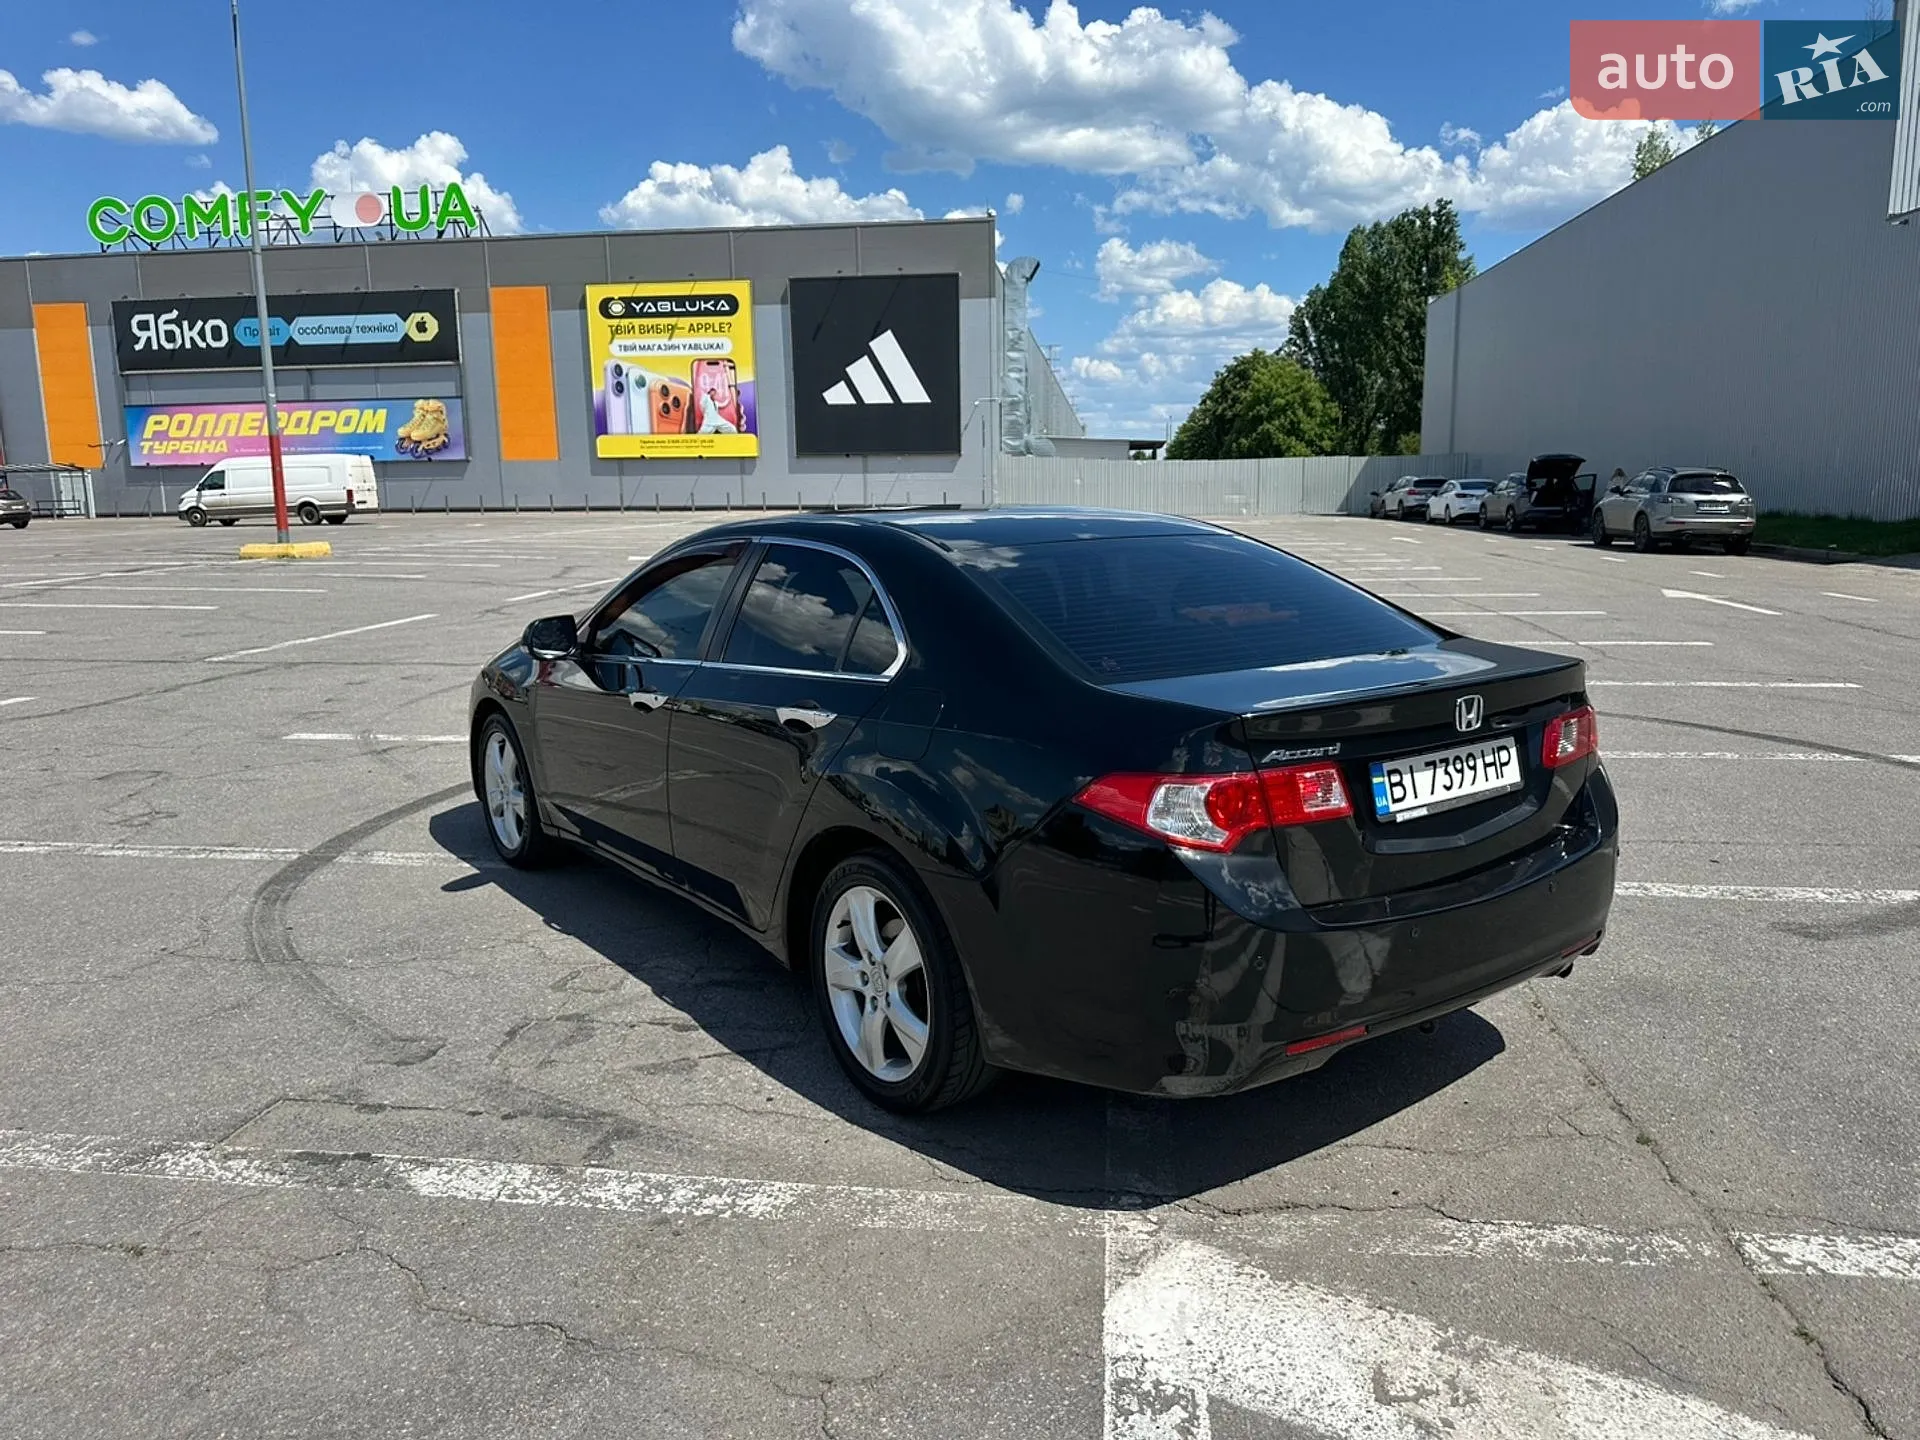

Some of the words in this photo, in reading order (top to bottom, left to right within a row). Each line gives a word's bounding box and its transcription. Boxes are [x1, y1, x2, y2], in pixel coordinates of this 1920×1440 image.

[87, 187, 327, 244] COMFY
[390, 182, 479, 233] UA
[630, 300, 730, 313] YABLUKA
[130, 308, 229, 351] Ябко
[298, 324, 352, 336] особлива
[355, 322, 398, 335] техніко!
[608, 322, 635, 335] ТВІЙ
[639, 323, 674, 335] ВИБІР
[688, 322, 732, 334] APPLE?
[618, 342, 636, 352] ТВІЙ
[639, 343, 680, 351] МАГАЗИН
[682, 342, 724, 351] YABLUKA!
[142, 408, 387, 438] РОЛЛЕРДРОМ
[140, 440, 229, 455] ТУРБІНА
[1261, 742, 1341, 764] Accord
[1388, 763, 1418, 805] BI
[1429, 752, 1479, 796] 7399
[1483, 745, 1512, 783] HP
[1376, 797, 1388, 807] UA
